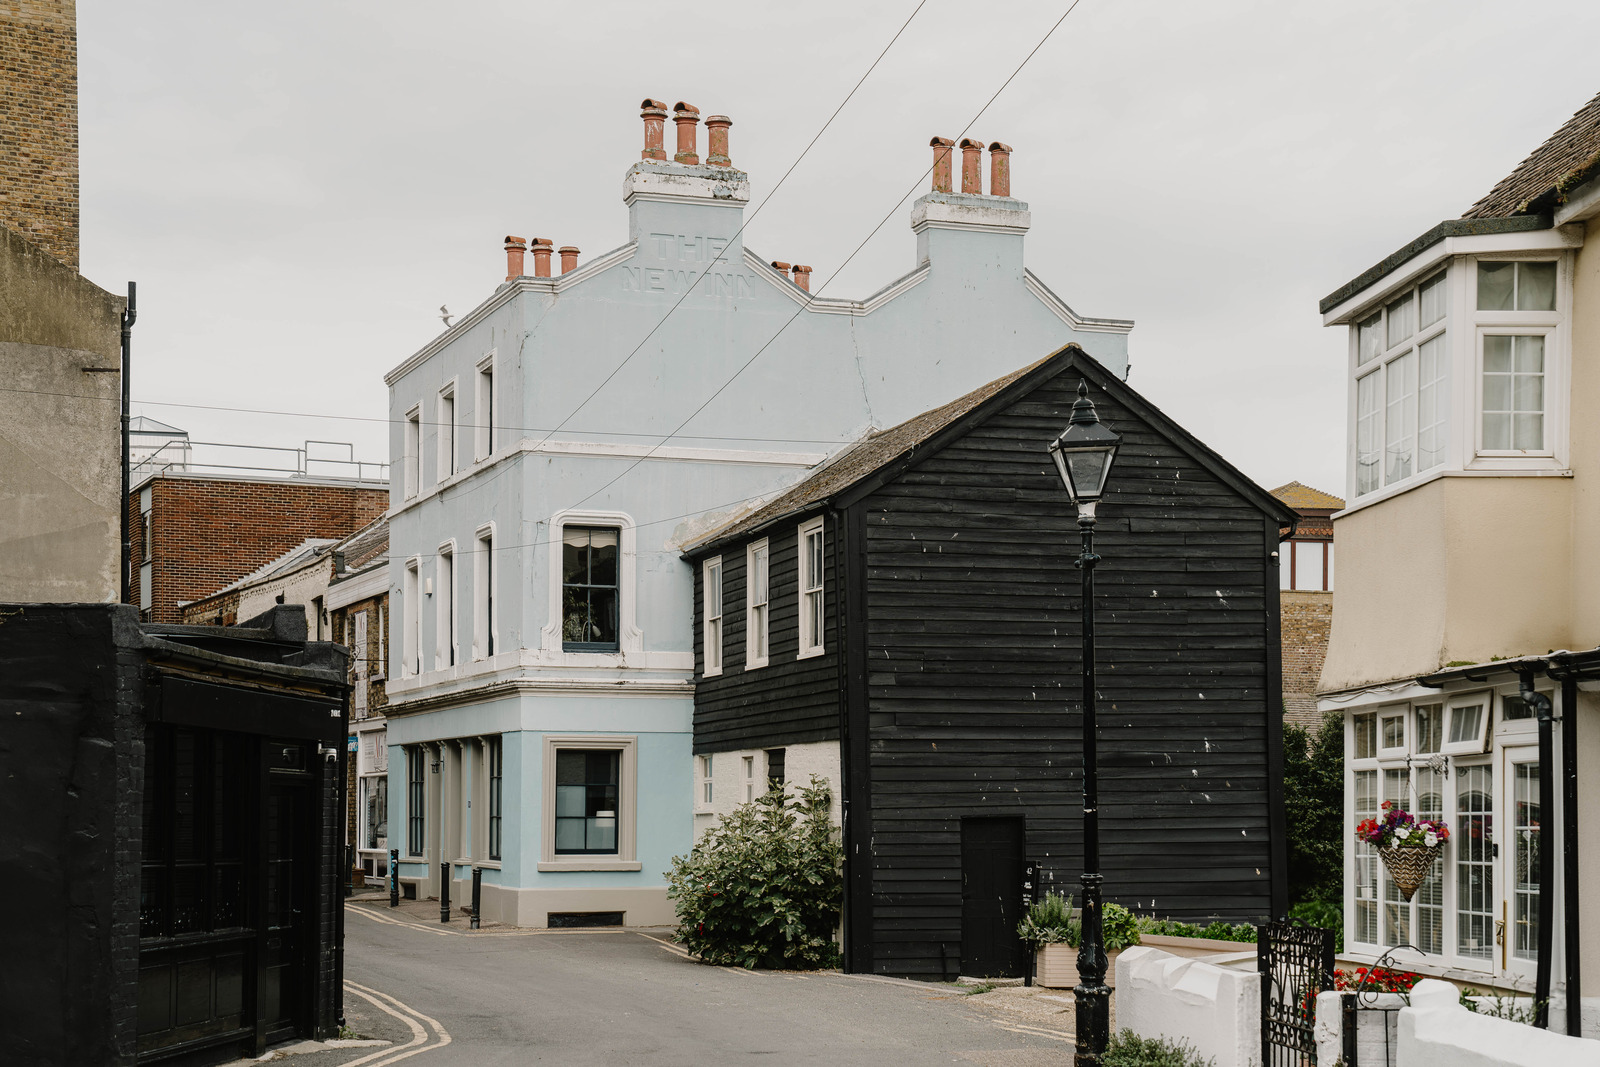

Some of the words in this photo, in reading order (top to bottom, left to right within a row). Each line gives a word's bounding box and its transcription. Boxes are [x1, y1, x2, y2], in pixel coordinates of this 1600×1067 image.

[650, 232, 729, 263] THE
[621, 265, 697, 295] NEW
[704, 271, 757, 300] INN
